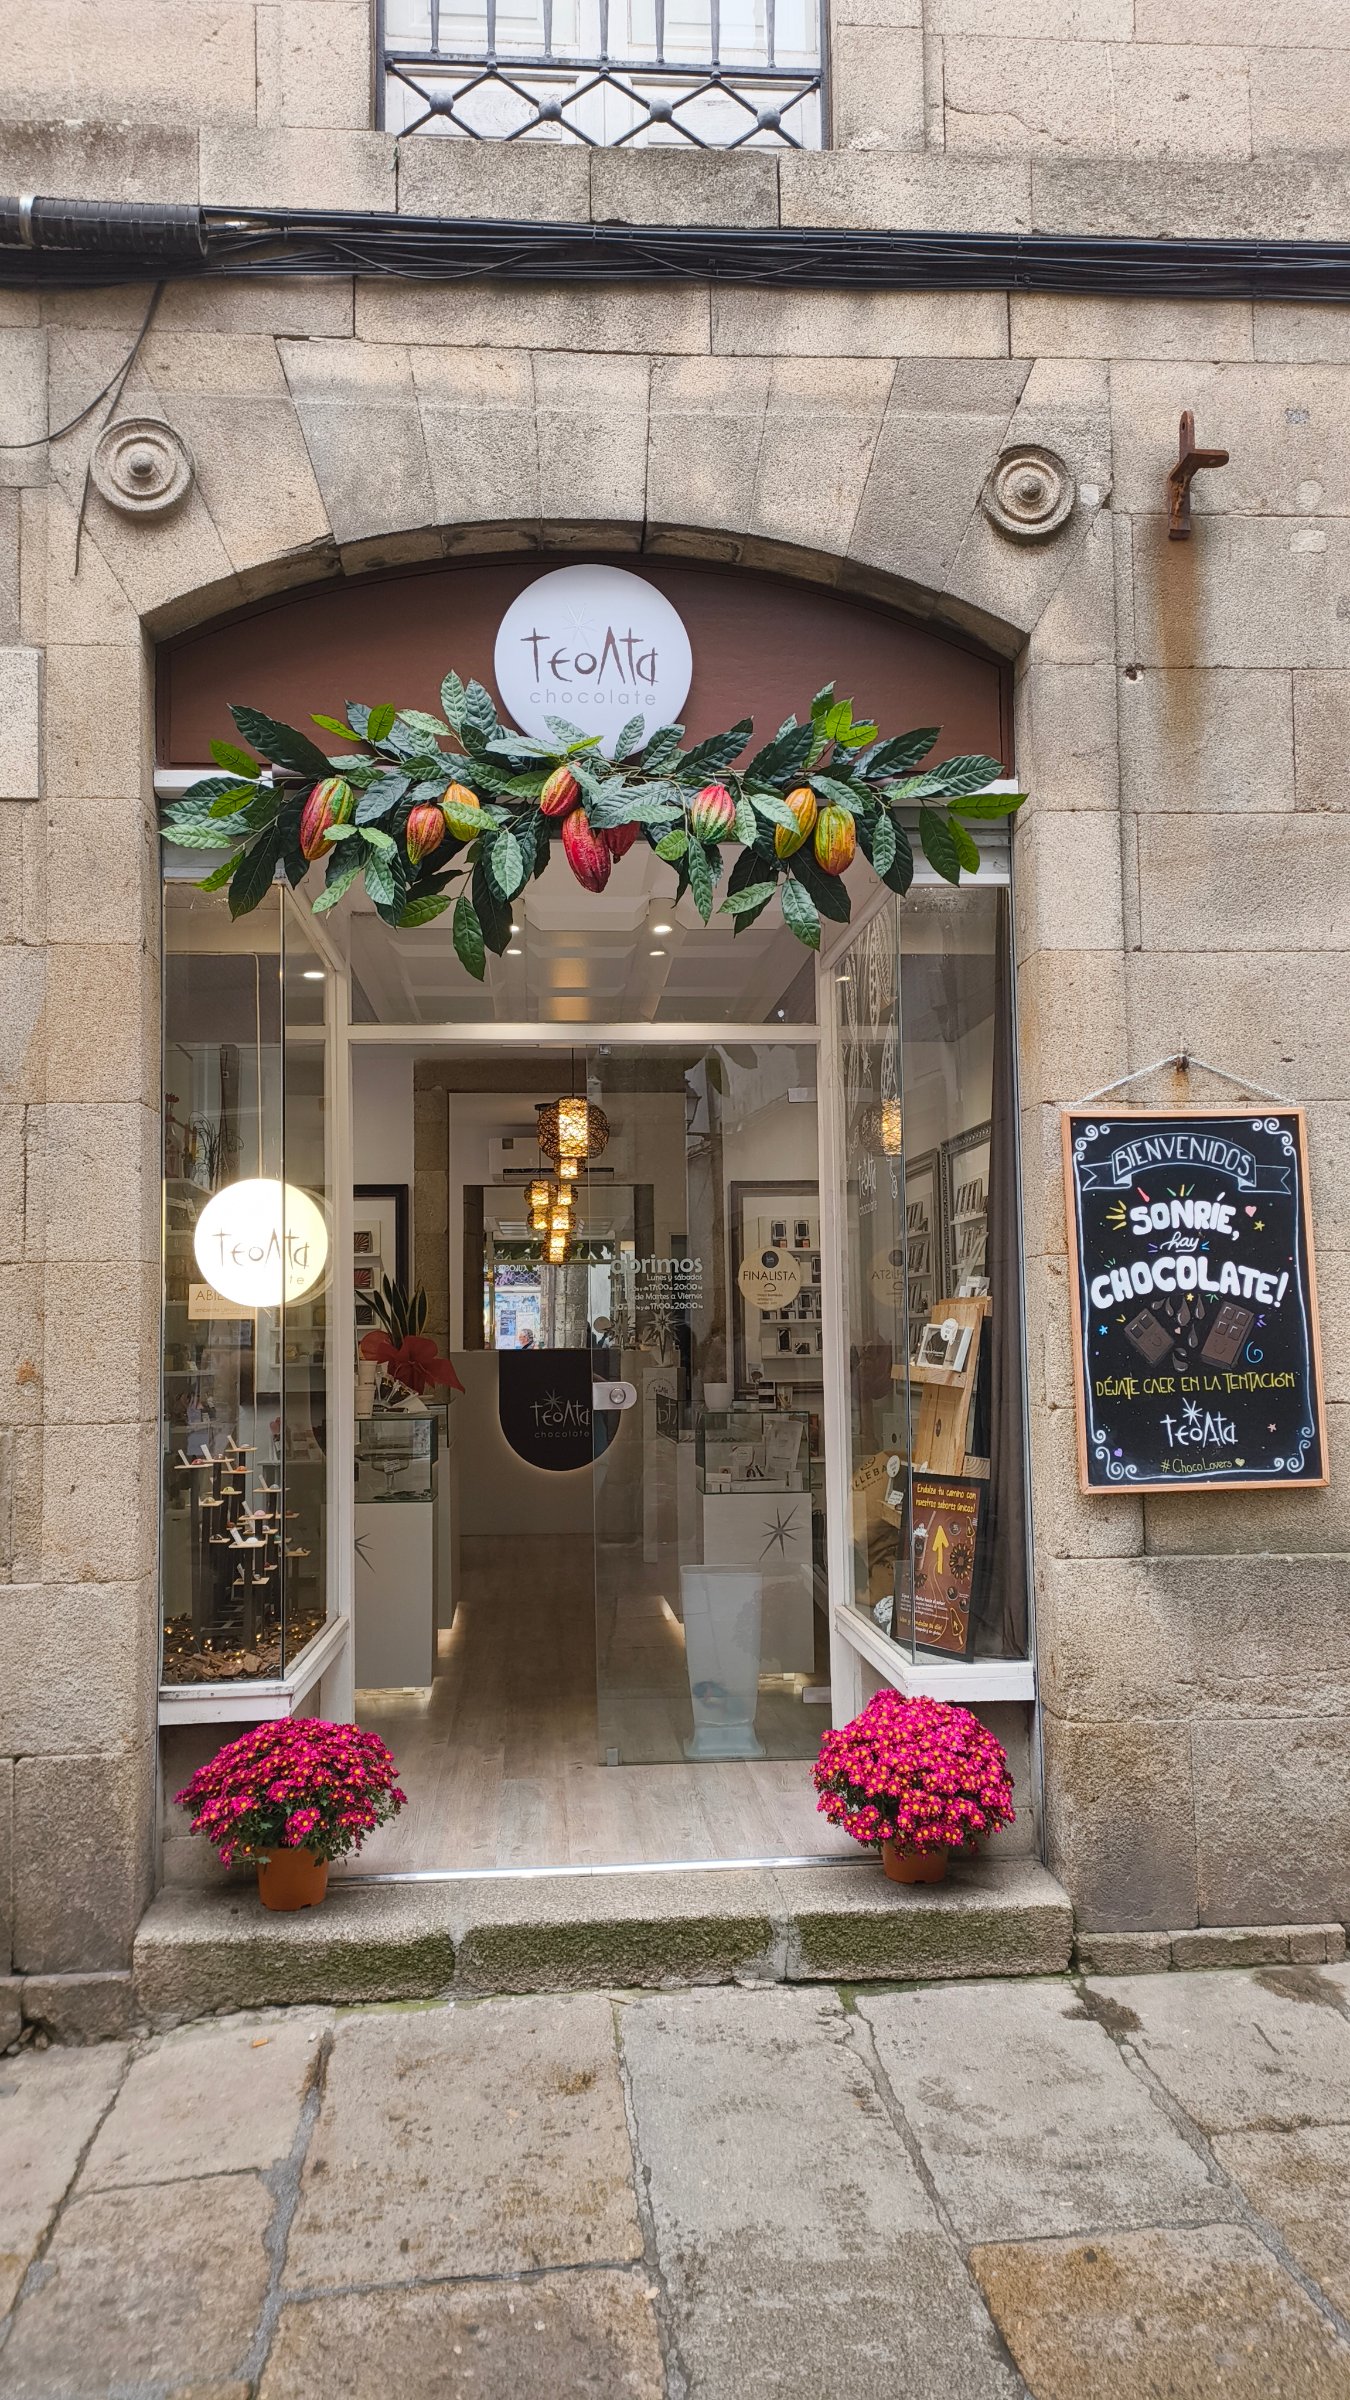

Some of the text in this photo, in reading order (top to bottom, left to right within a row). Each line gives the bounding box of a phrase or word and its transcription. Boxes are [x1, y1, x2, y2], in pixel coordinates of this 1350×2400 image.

[529, 689, 656, 706] chocolate
[1114, 1136, 1252, 1177] BIENVENIDOS
[1160, 1231, 1200, 1252] hay
[611, 1253, 703, 1274] abrimos
[646, 1273, 667, 1281] Lunes
[674, 1273, 703, 1281] sábados
[743, 1270, 797, 1281] FINALISTA
[649, 1283, 669, 1291] 17:00
[673, 1283, 698, 1291] 20:00
[1091, 1255, 1289, 1309] CHOCOLATE!
[645, 1292, 669, 1300] Martes
[677, 1291, 703, 1300] Viernes
[650, 1302, 671, 1310] 17:00
[674, 1302, 698, 1310] 20:00
[1096, 1371, 1296, 1400] DÉJATE CAER EN LA TENTACIÓN
[534, 1430, 590, 1439] chocolate
[946, 1489, 965, 1499] camino
[966, 1492, 977, 1500] con
[915, 1498, 937, 1509] nuestros
[937, 1499, 957, 1511] sabores
